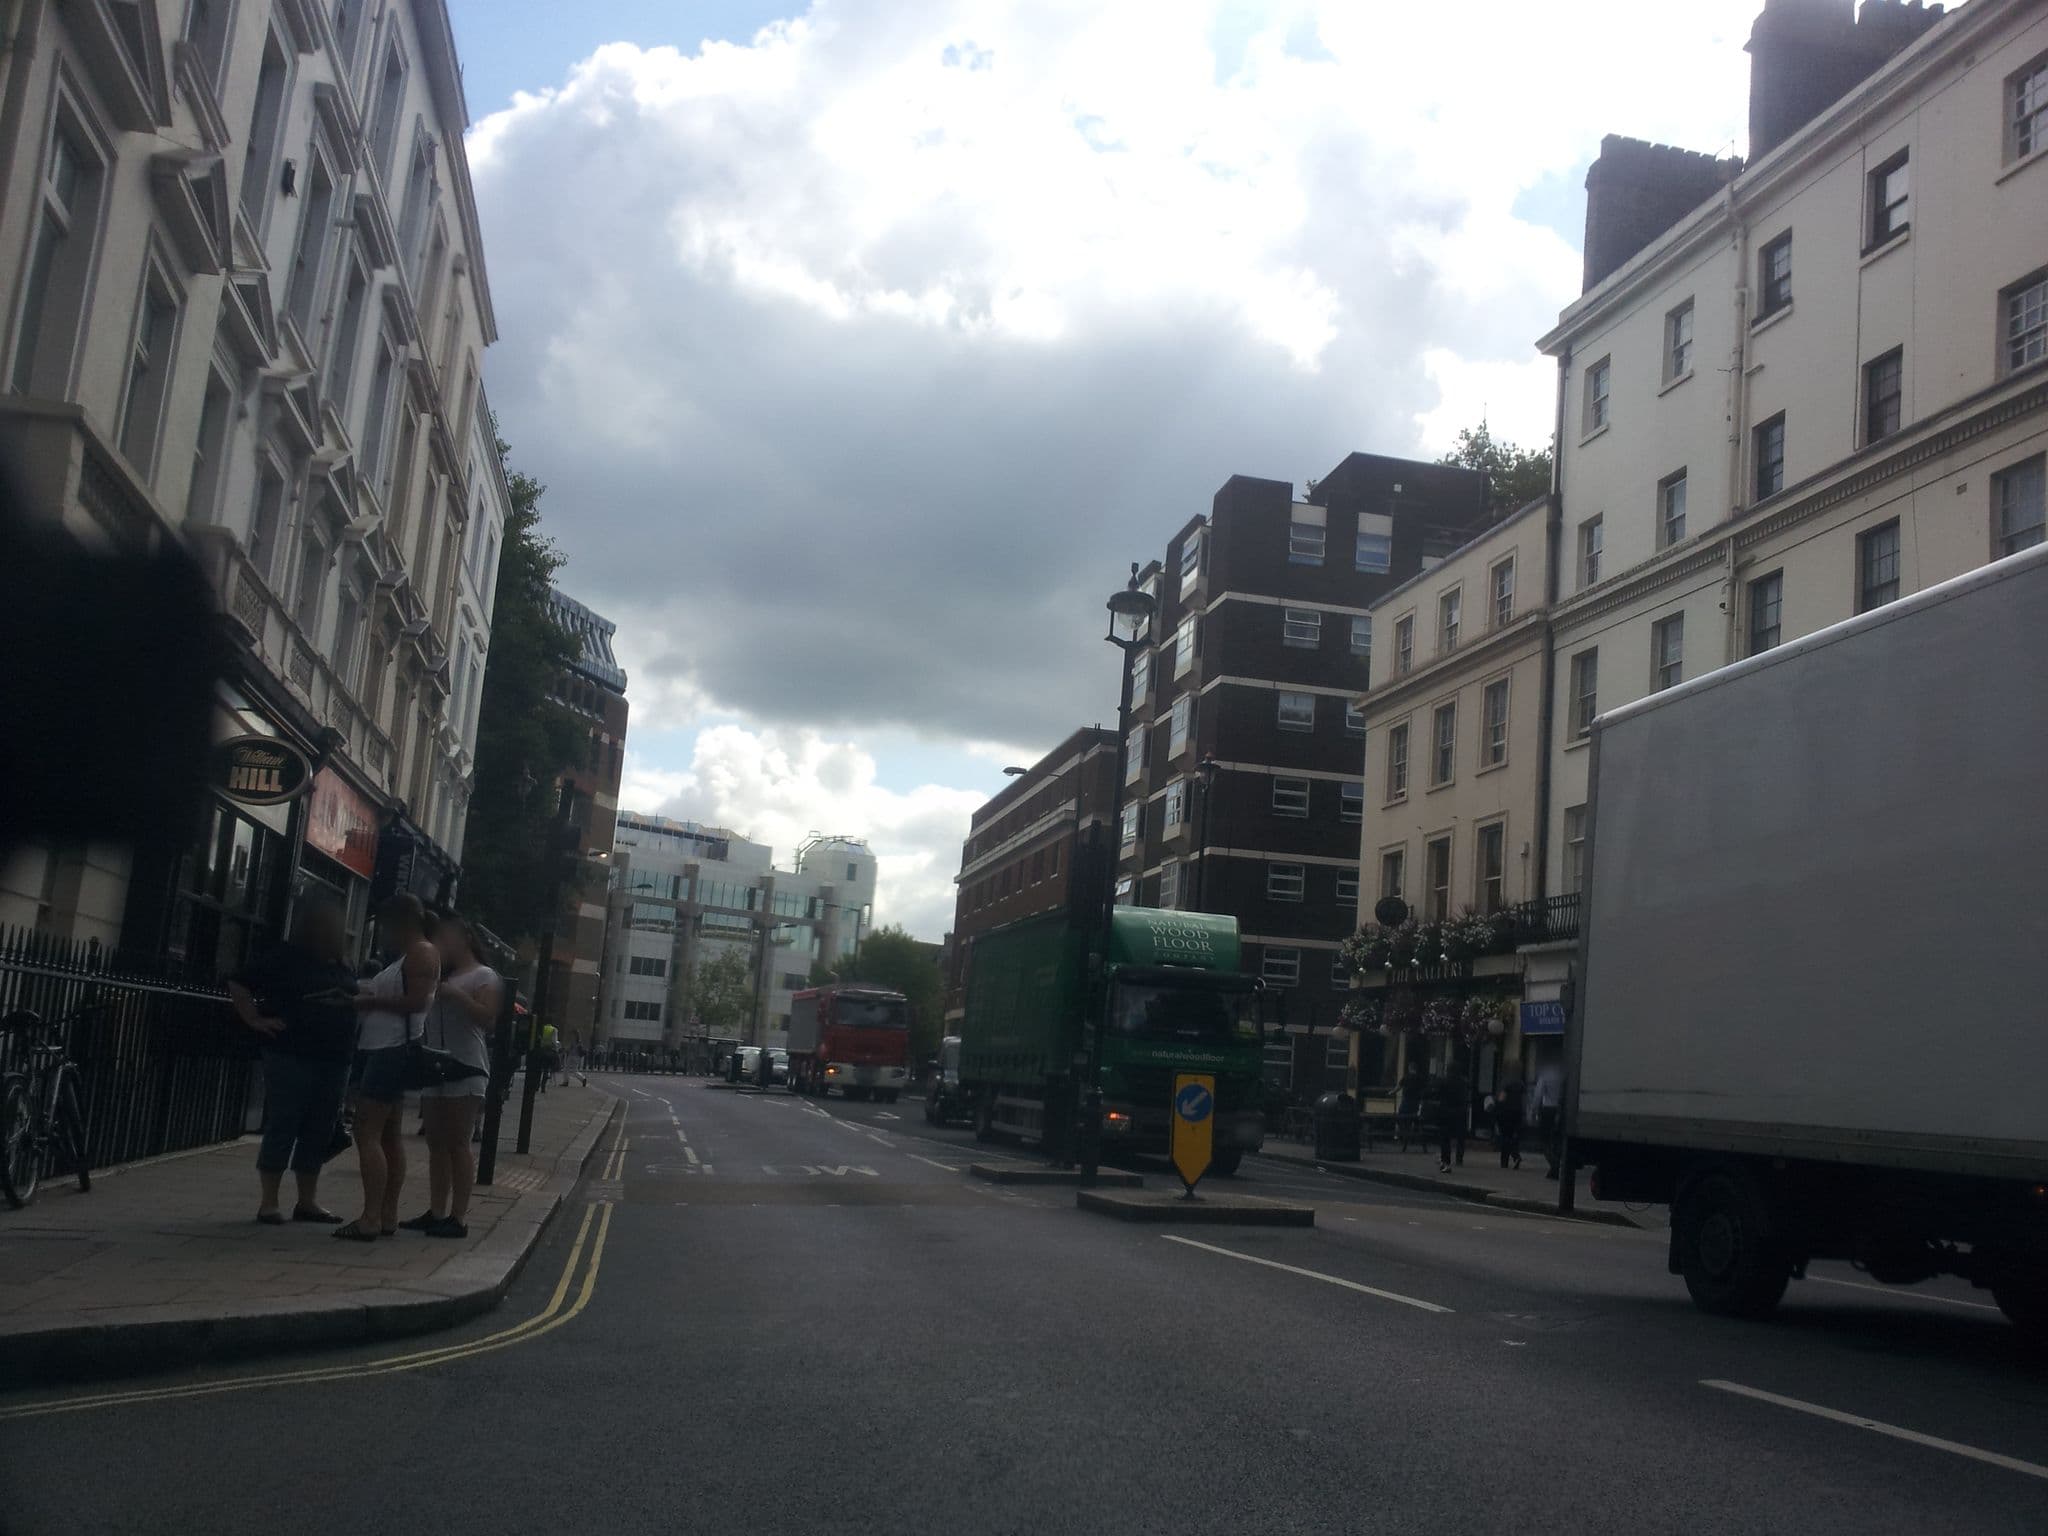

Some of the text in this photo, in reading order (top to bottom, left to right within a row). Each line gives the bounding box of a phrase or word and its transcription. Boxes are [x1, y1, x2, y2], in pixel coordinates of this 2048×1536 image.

[229, 766, 283, 792] HILL
[1148, 919, 1204, 930] NATURAL
[1150, 926, 1209, 939] WOOD
[1153, 937, 1214, 952] FLOOR
[1528, 1004, 1549, 1017] TOP
